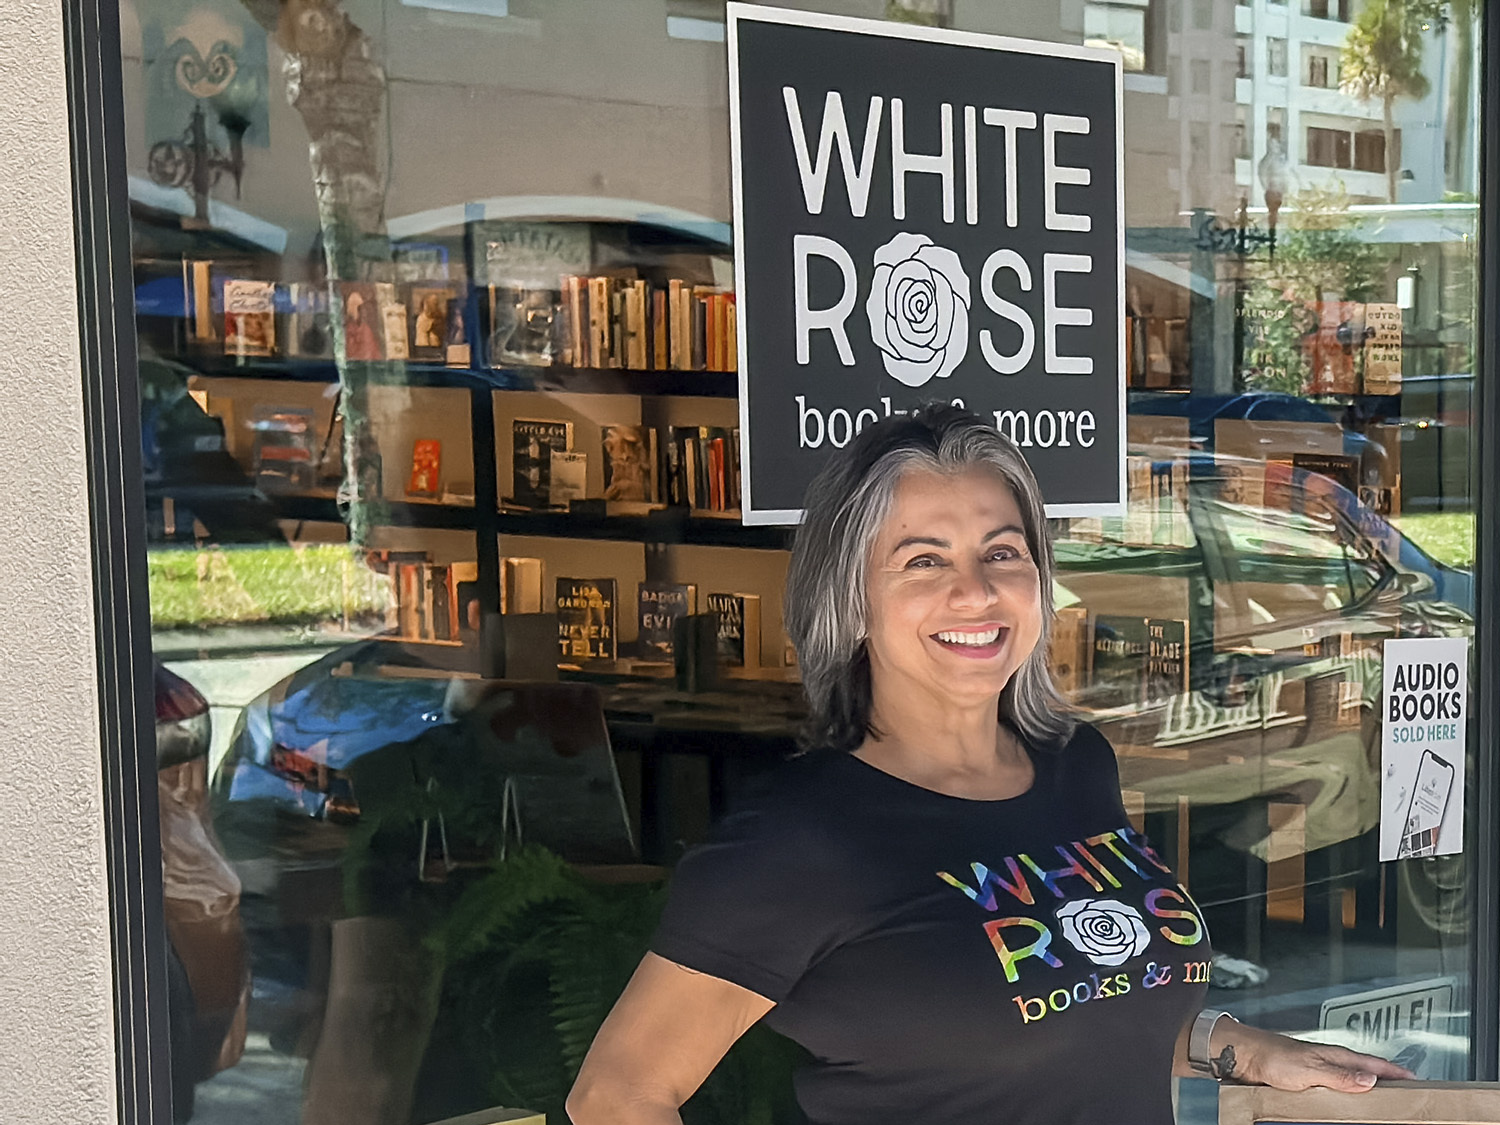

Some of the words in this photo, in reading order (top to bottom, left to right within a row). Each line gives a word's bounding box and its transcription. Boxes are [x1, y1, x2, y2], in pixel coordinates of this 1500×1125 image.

[782, 86, 1091, 232] WHITE
[993, 408, 1096, 448] more
[559, 622, 611, 638] NEVER
[558, 640, 609, 657] TELL
[1392, 662, 1460, 693] AUDIO
[1389, 691, 1462, 722] BOOKS
[1393, 725, 1425, 744] SOLD
[1427, 724, 1456, 742] HERE
[1012, 972, 1131, 1024] books
[1141, 961, 1173, 988] &
